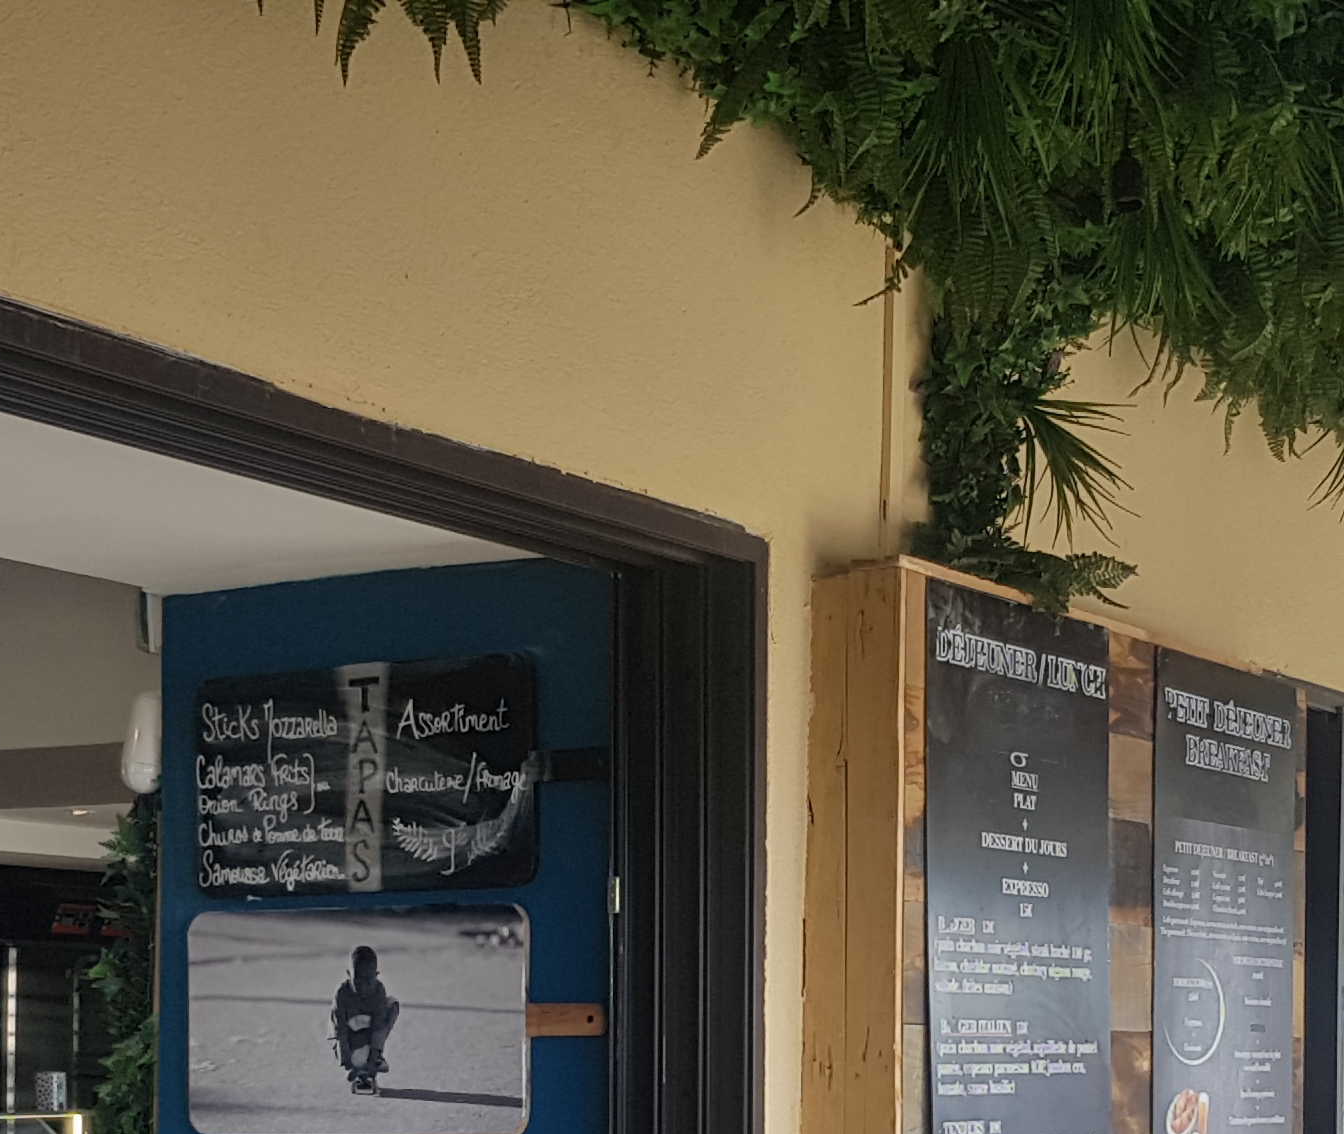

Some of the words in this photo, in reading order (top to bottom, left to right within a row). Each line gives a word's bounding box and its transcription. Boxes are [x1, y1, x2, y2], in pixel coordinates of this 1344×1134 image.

[936, 624, 1038, 683] DÉJEUNER
[202, 703, 259, 741] Sticks
[397, 698, 510, 739] Assortiment
[1165, 687, 1209, 729] PETIT
[1213, 699, 1292, 750] DÉJEUNER
[1185, 733, 1271, 782] BREAKFAST
[349, 676, 380, 883] TAPAS
[1011, 770, 1039, 791] MENU
[248, 787, 298, 823] Rings
[1013, 793, 1036, 810] PLAT
[981, 832, 1023, 852] DESSERT
[1025, 839, 1038, 854] DU
[1039, 841, 1067, 857] JOURS
[199, 850, 270, 887] Samoussa
